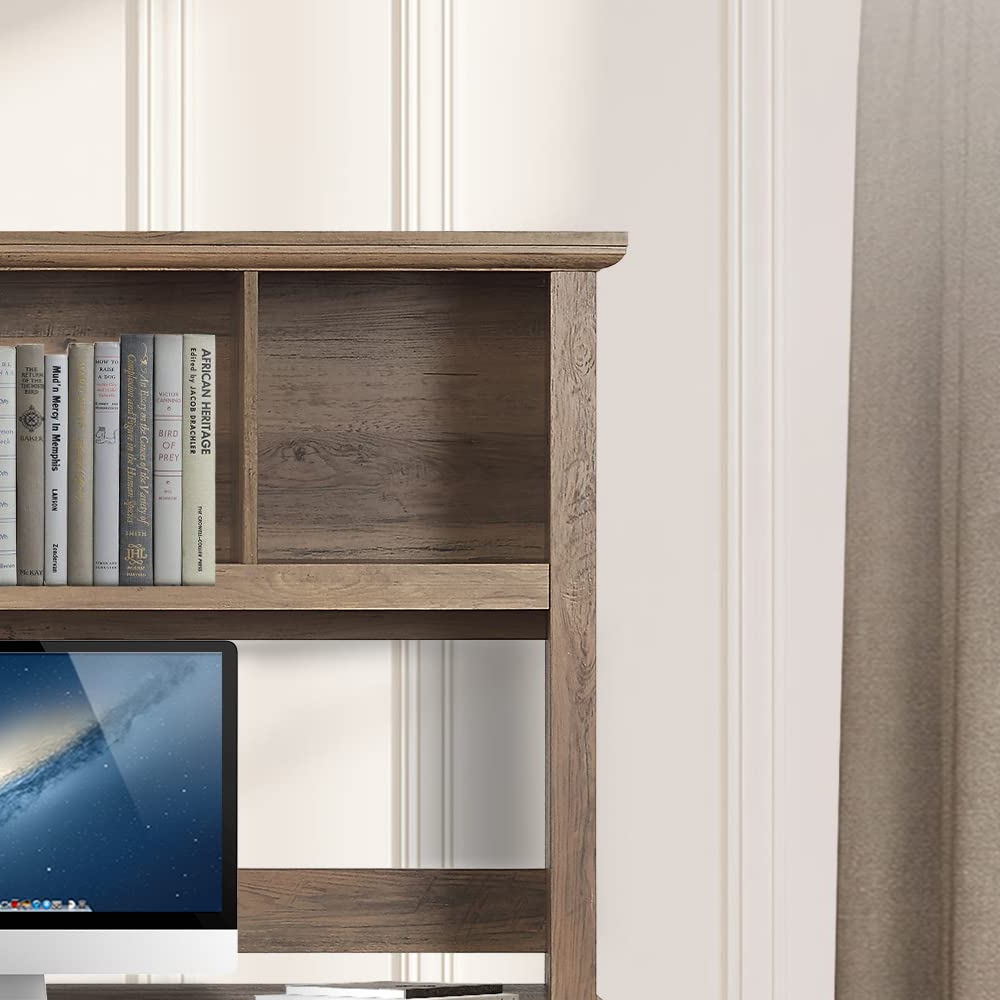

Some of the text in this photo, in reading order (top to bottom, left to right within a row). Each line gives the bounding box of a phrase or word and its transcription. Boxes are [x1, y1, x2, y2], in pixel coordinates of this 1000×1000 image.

[124, 354, 136, 397] Complexion
[189, 374, 197, 383] by
[127, 399, 136, 416] and
[201, 348, 211, 455] AFRICAN HERITAGE
[50, 365, 61, 472] Mud'n Mercy In Memphis
[124, 417, 136, 440] Figure
[158, 429, 178, 437] BIRD
[127, 443, 135, 451] in
[137, 374, 149, 526] An Essay on the Causes of the Variety of
[162, 441, 176, 449] OF
[127, 453, 136, 464] the
[127, 466, 136, 497] Human
